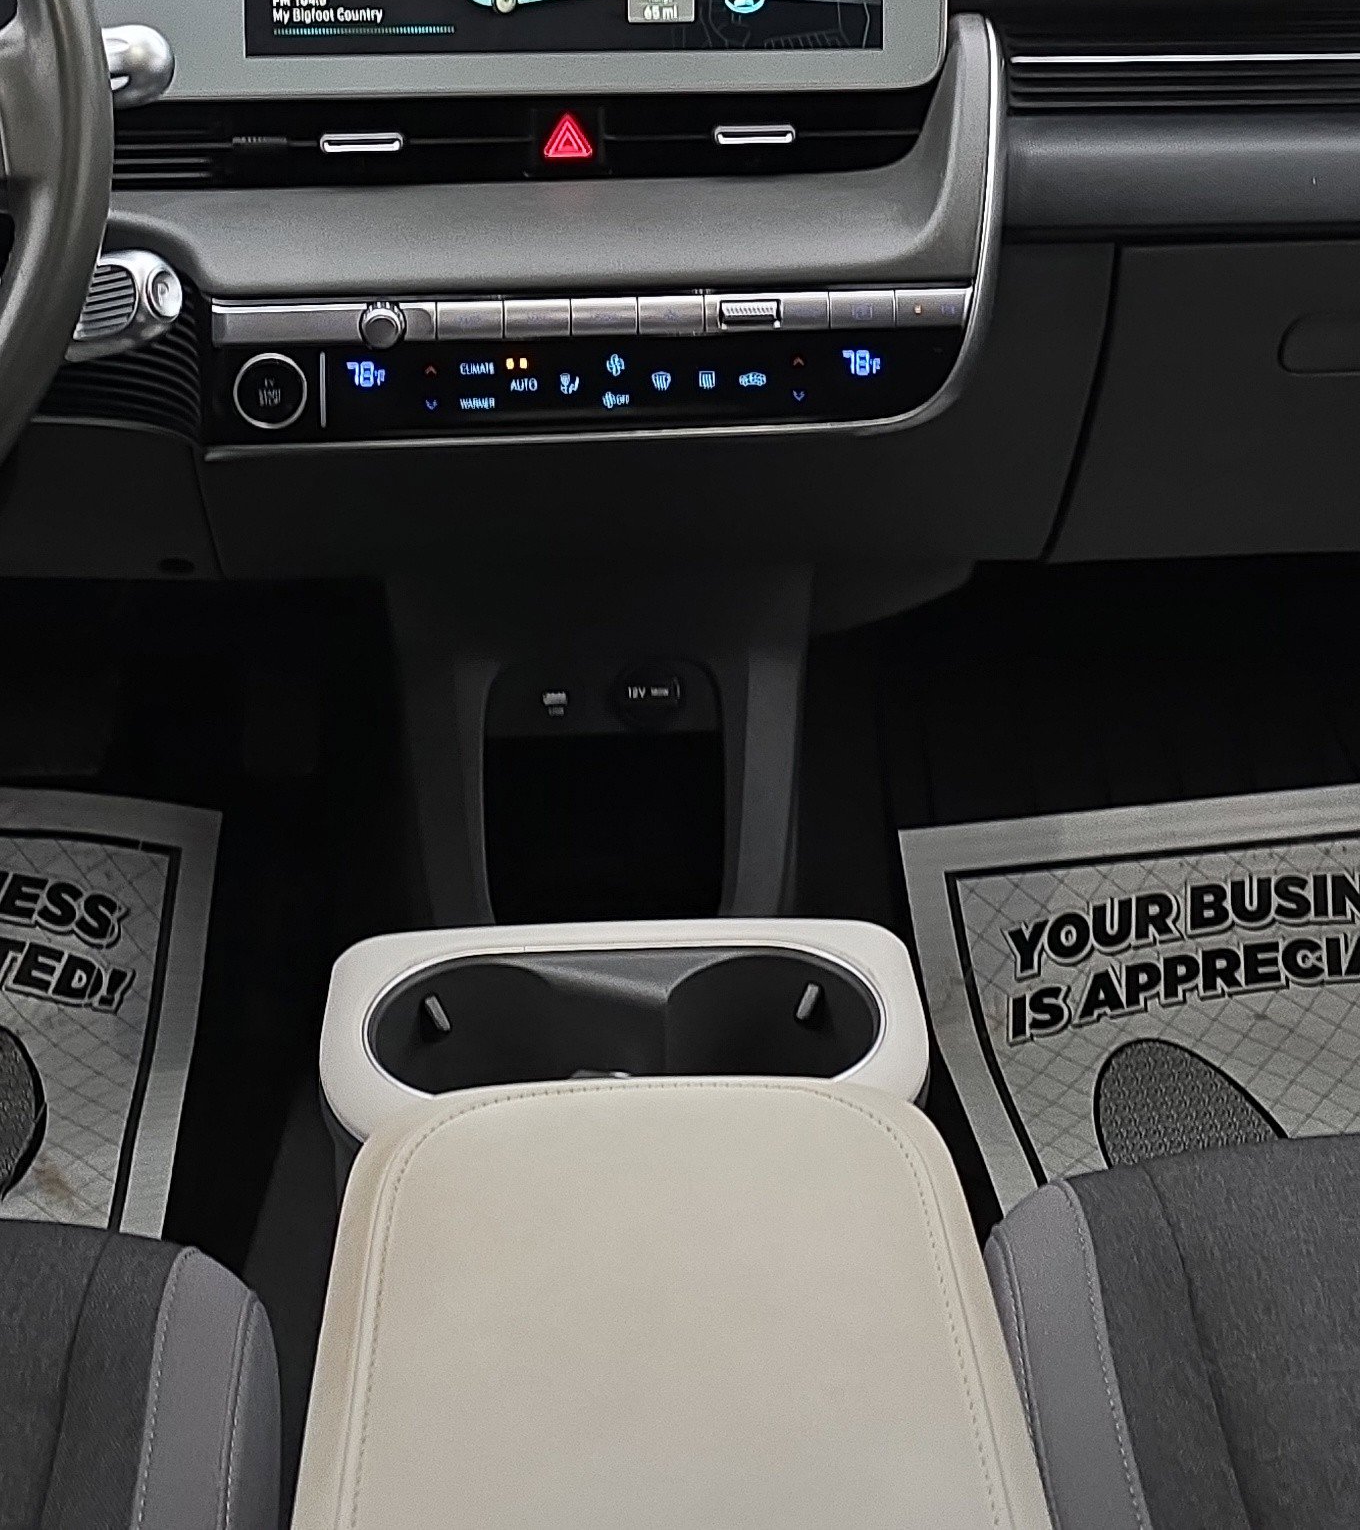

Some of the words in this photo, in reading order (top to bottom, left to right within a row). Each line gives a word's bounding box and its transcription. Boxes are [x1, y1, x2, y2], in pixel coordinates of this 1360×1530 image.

[272, 7, 291, 25] My
[292, 7, 335, 25] Bigfoot
[336, 7, 384, 24] Country
[510, 377, 538, 392] AUTO
[1003, 891, 1179, 981] YOUR
[1006, 983, 1072, 1047] IS
